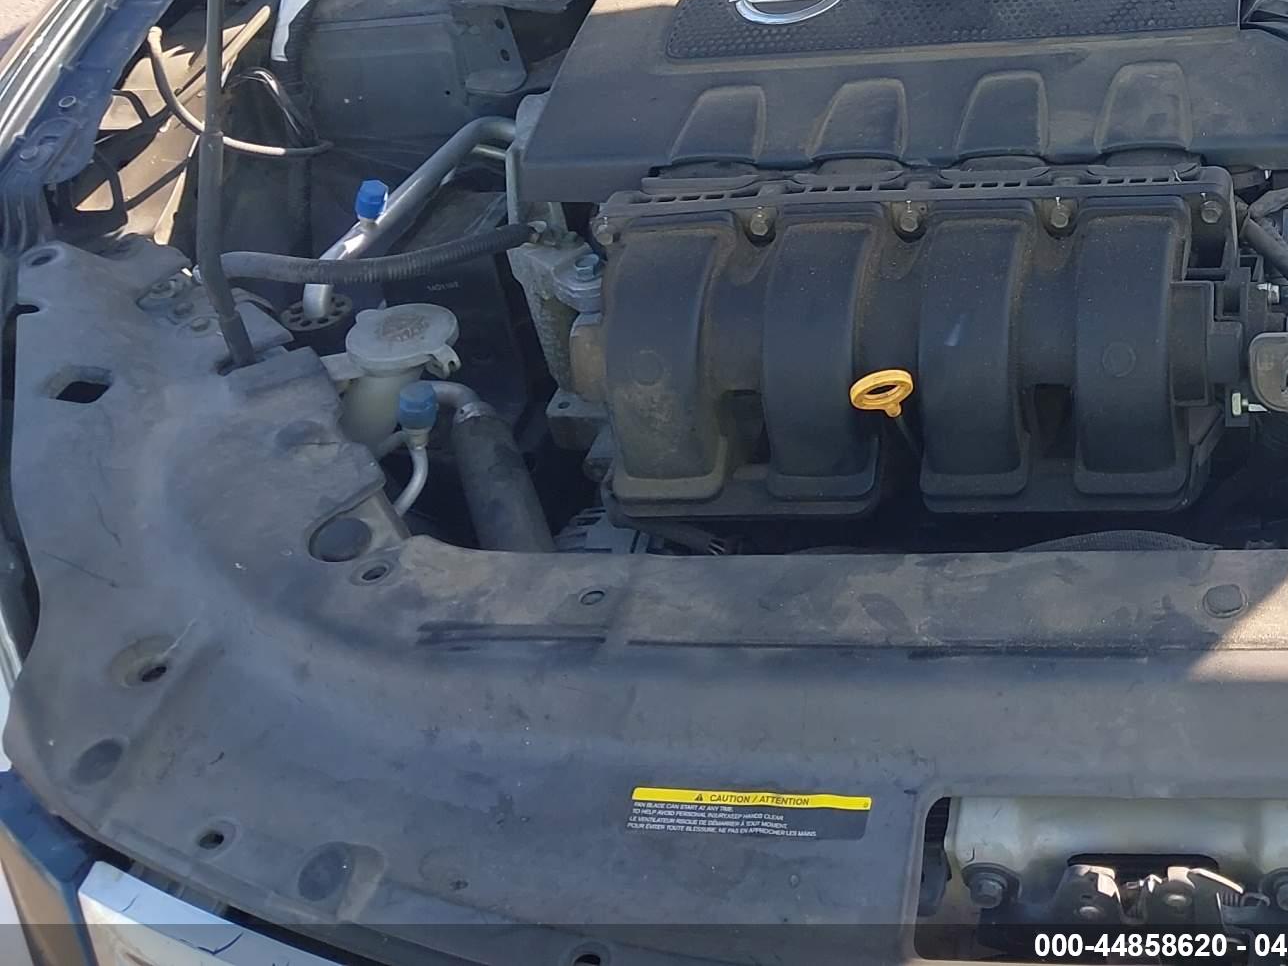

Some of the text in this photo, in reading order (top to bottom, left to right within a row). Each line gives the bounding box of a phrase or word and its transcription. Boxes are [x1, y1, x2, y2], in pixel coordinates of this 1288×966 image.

[710, 794, 810, 806] CAUTION / ATTENTION
